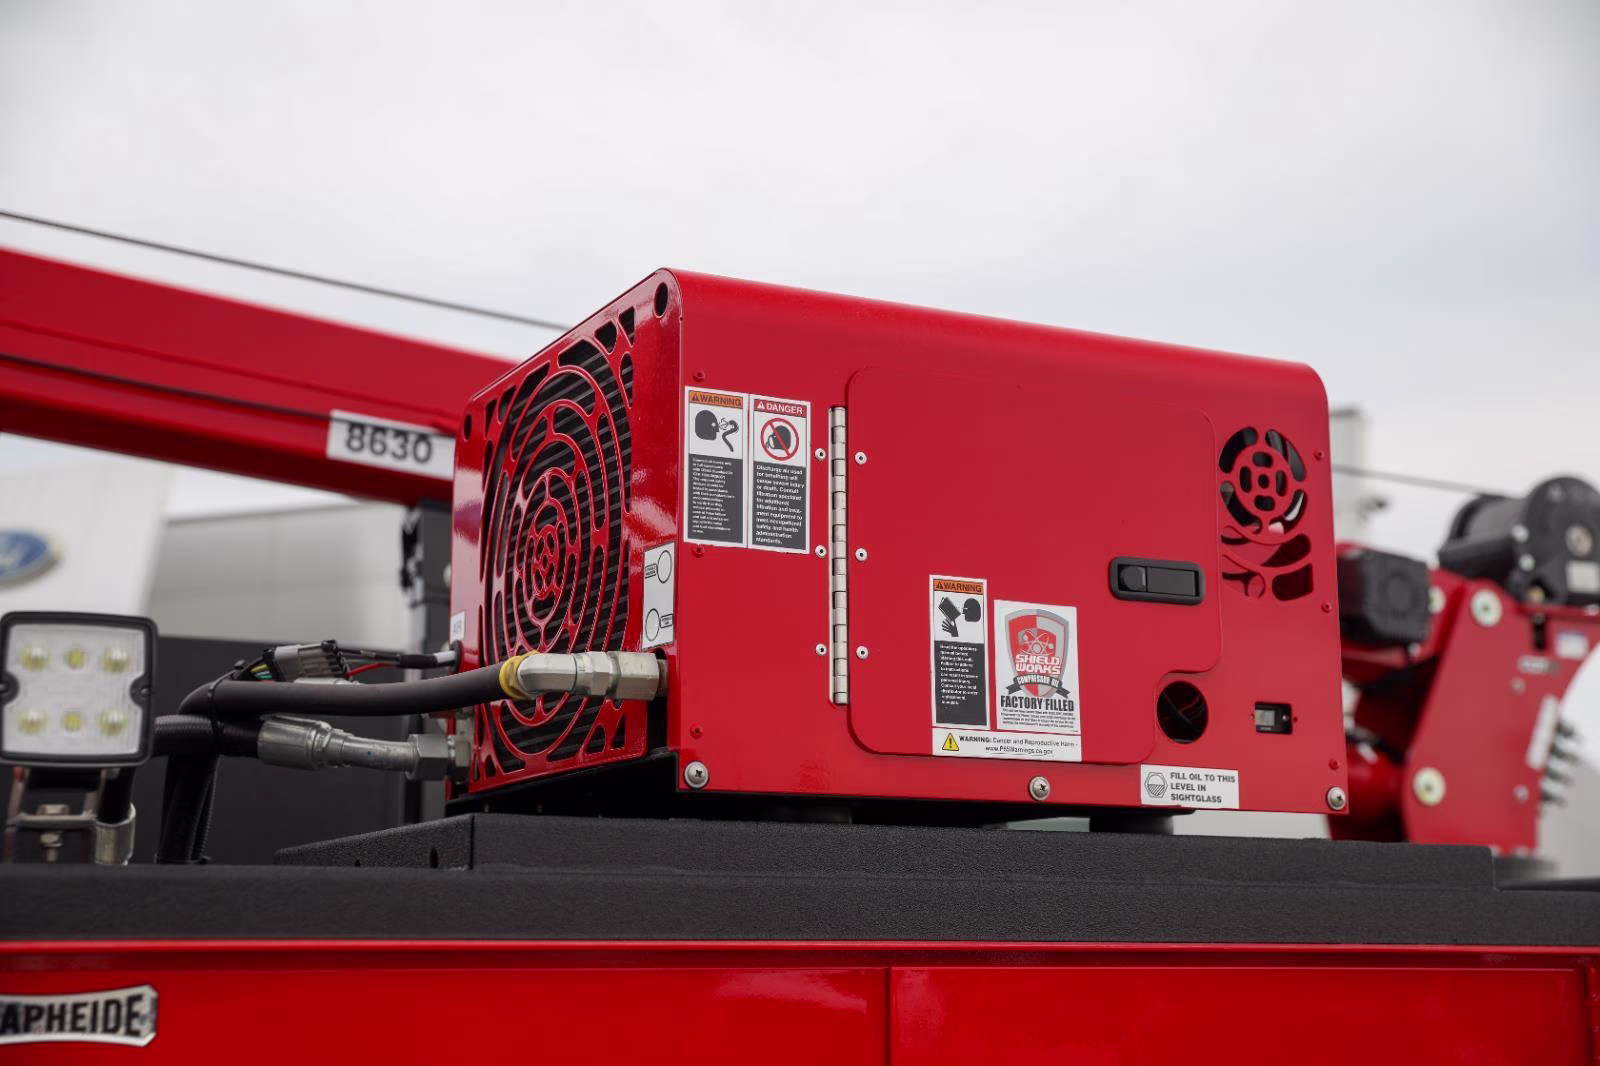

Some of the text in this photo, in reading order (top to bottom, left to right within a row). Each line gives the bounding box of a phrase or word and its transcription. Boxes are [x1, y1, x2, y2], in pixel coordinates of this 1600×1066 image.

[700, 394, 742, 406] WARNING
[766, 402, 803, 415] DANGER
[346, 421, 432, 464] 8630
[943, 582, 982, 592] WARNING
[1015, 654, 1060, 666] SHIELD
[1015, 663, 1061, 675] WORKS
[1000, 695, 1043, 710] FACTORY
[1045, 698, 1075, 712] FILLED
[959, 735, 992, 743] WARNING:
[1024, 739, 1060, 747] Reproductive
[1170, 772, 1236, 783] FILL OIL TO THIS
[1170, 782, 1196, 791] LEVEL
[1170, 793, 1222, 803] SIGHTGLASS
